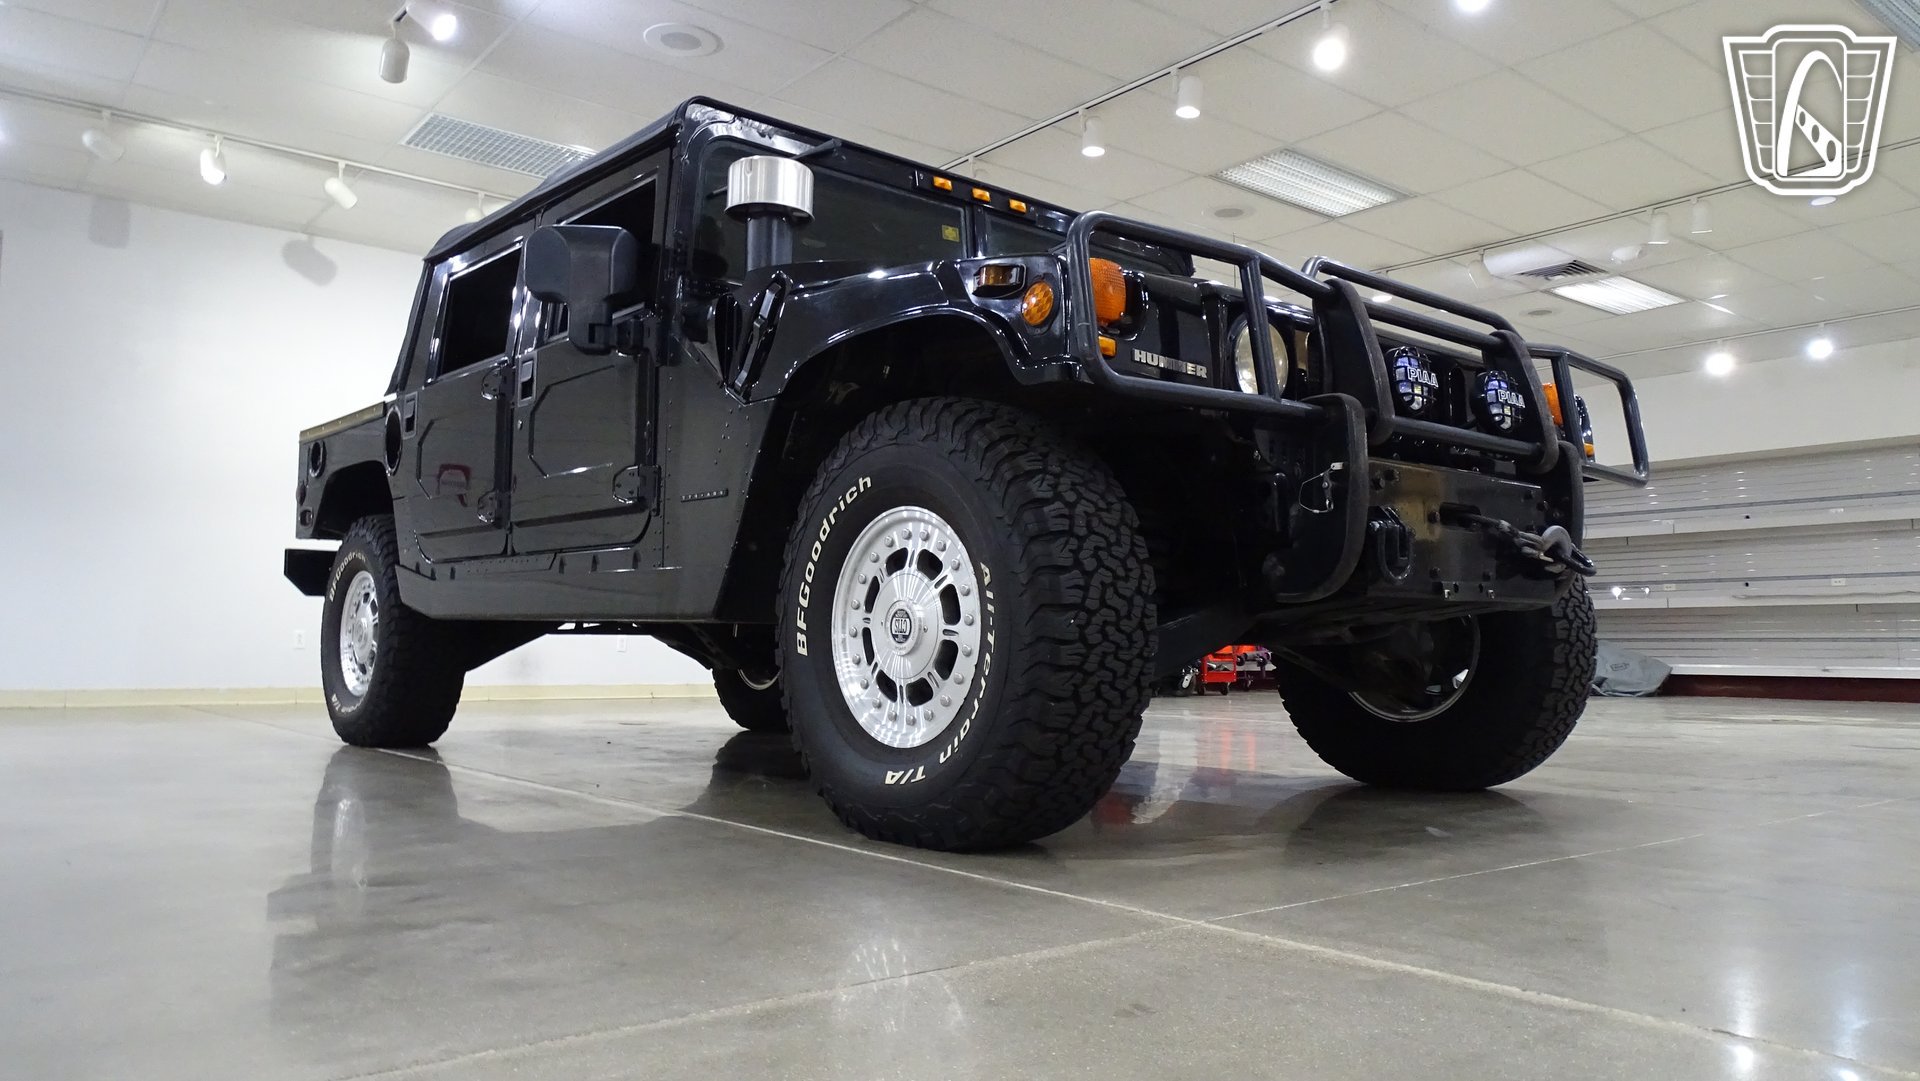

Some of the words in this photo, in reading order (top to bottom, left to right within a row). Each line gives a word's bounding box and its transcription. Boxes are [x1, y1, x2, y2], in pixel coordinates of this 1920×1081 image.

[1133, 348, 1208, 379] HUMMER
[1407, 366, 1439, 388] PIAA
[1498, 389, 1525, 408] PIAA
[795, 475, 872, 656] BFGoodrich
[939, 561, 997, 765] All-Terrain
[883, 765, 927, 787] T/A
